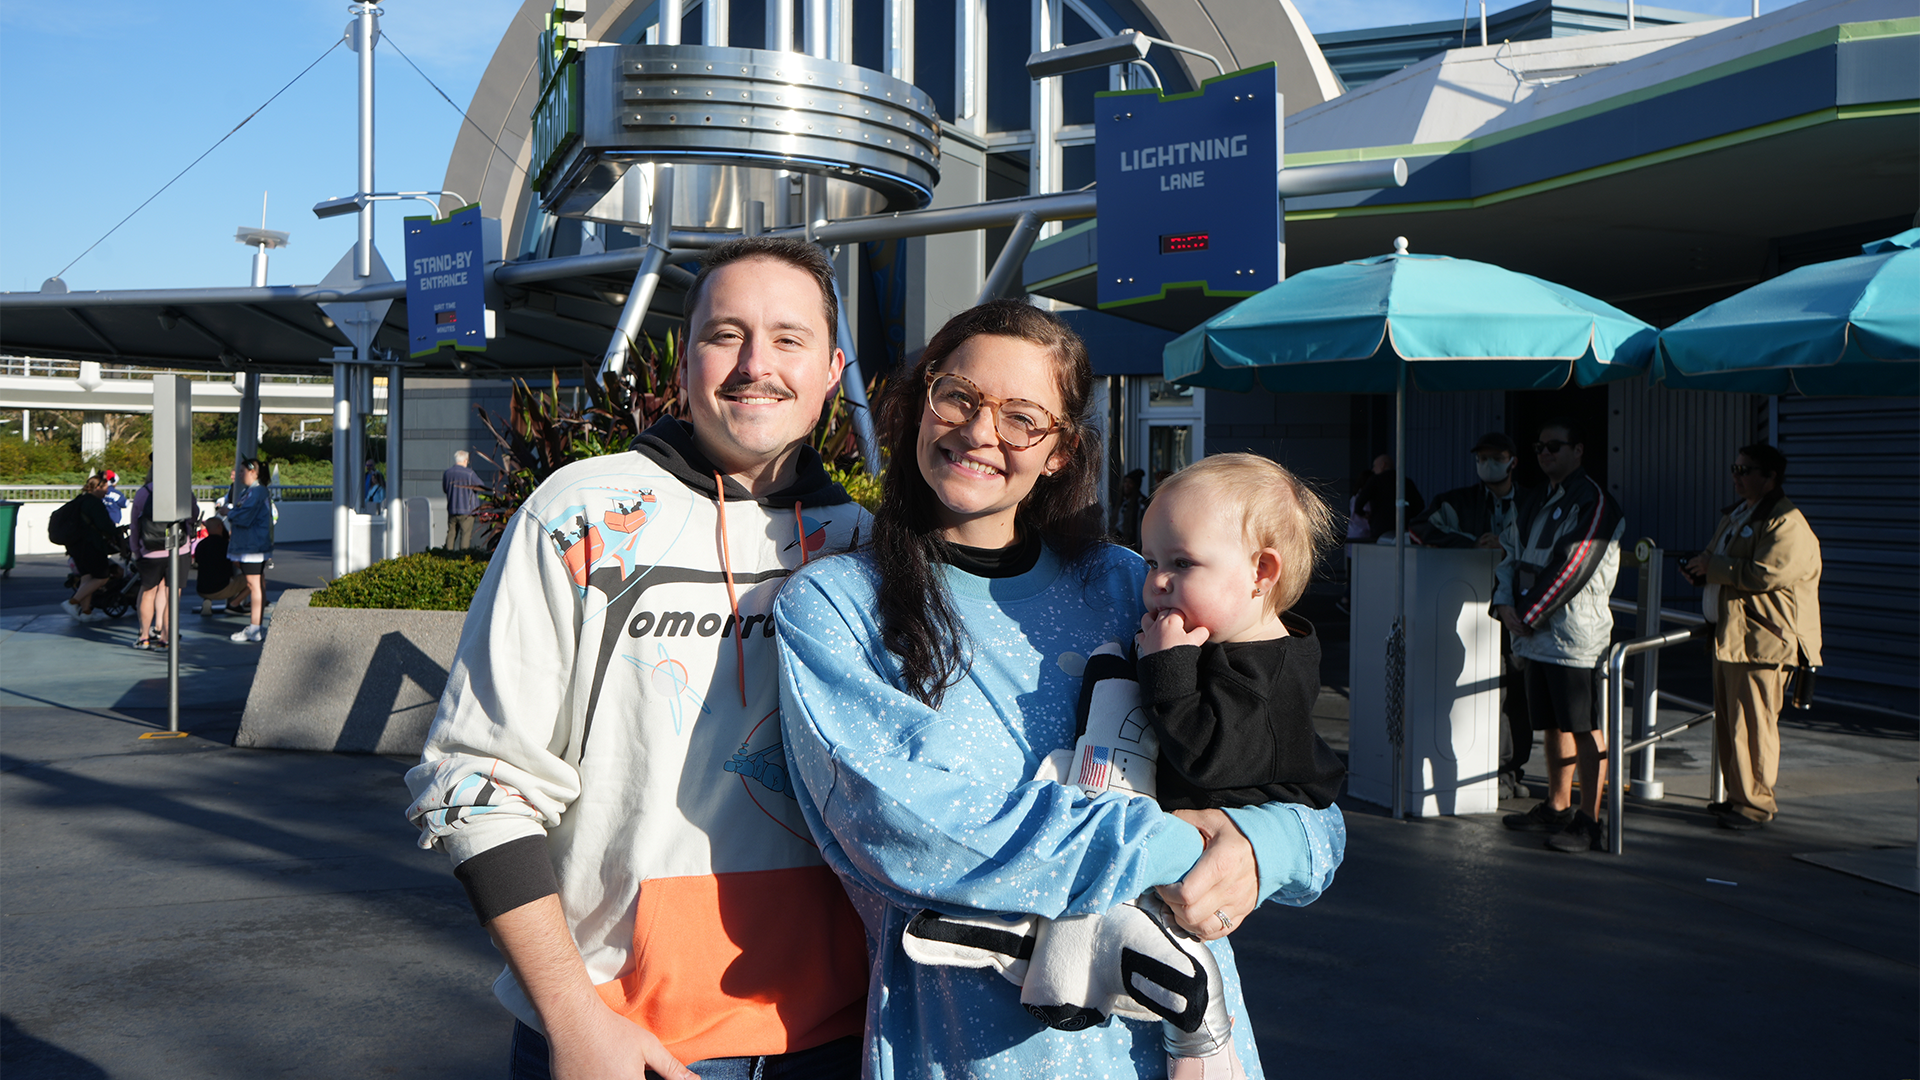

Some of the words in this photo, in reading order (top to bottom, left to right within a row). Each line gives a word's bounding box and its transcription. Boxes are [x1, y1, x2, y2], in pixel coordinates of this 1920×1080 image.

[1121, 134, 1247, 172] LIGHTNING
[1160, 171, 1205, 191] LANE
[413, 250, 472, 276] STAND-BY
[420, 272, 468, 290] ENTRANCE
